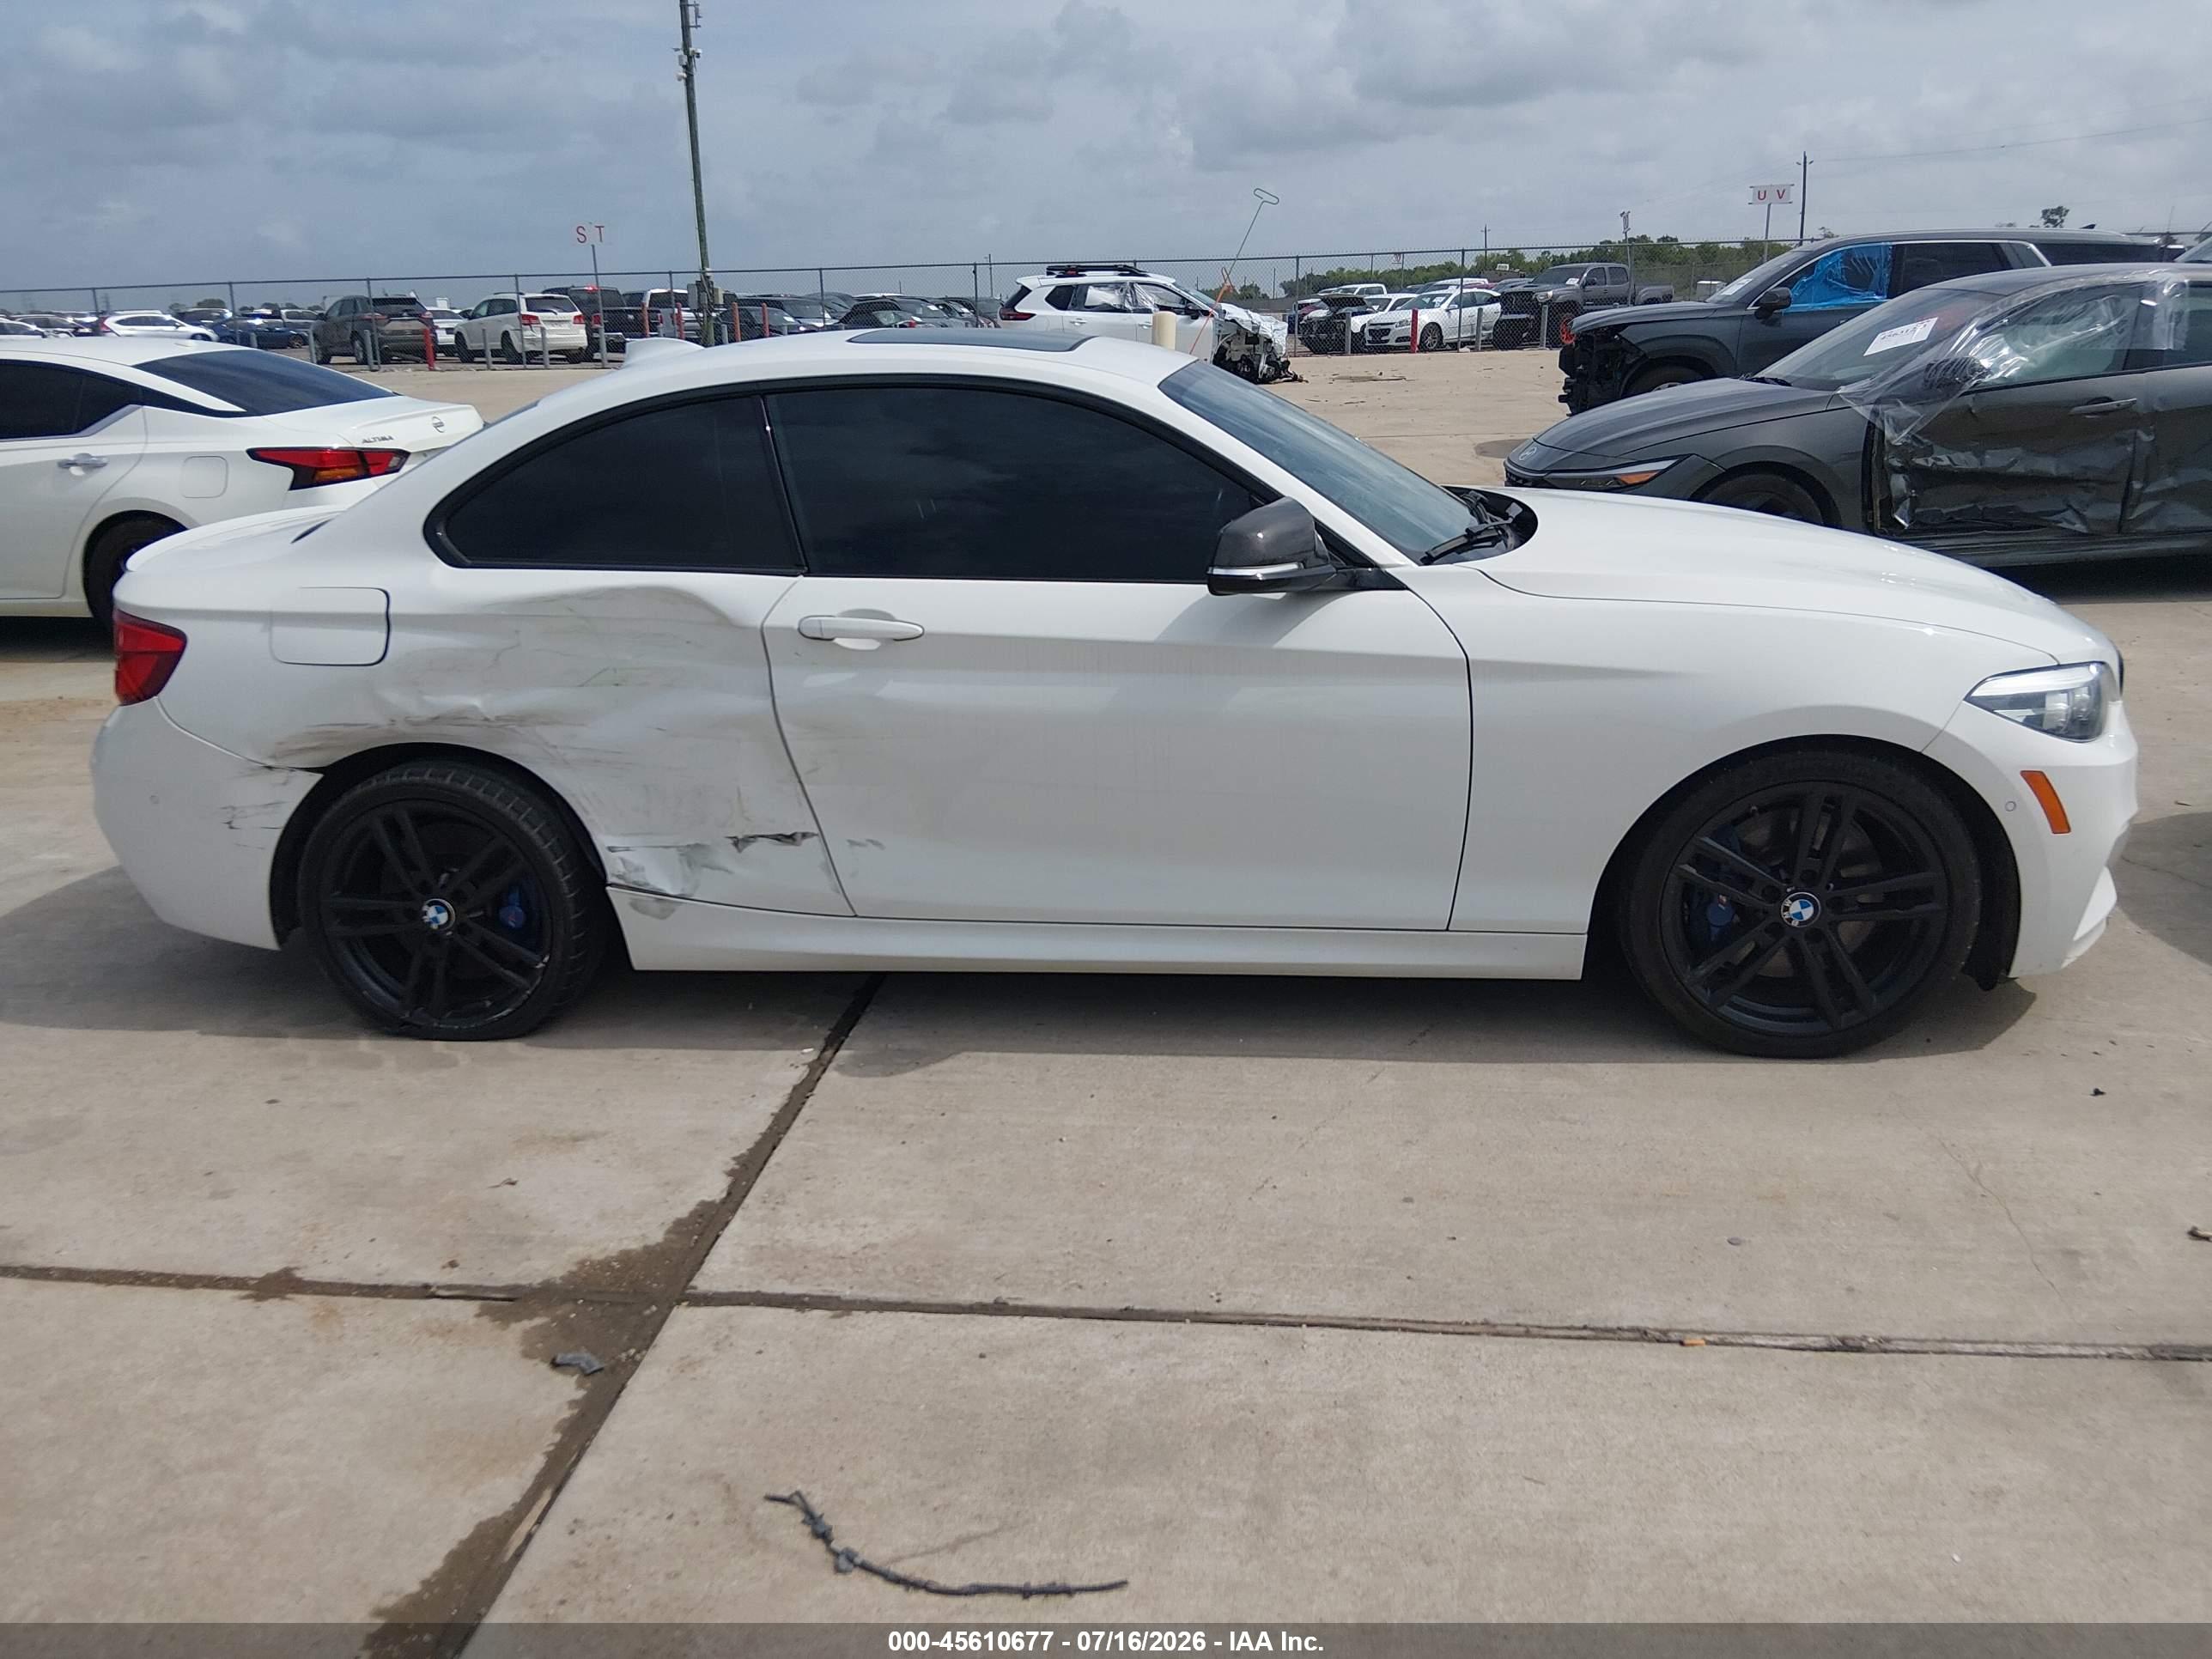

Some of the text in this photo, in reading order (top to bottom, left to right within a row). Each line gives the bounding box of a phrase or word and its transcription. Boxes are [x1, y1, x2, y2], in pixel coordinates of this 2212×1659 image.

[1758, 189, 1786, 200] U V
[576, 225, 605, 244] S T
[362, 434, 394, 444] ALTIMA
